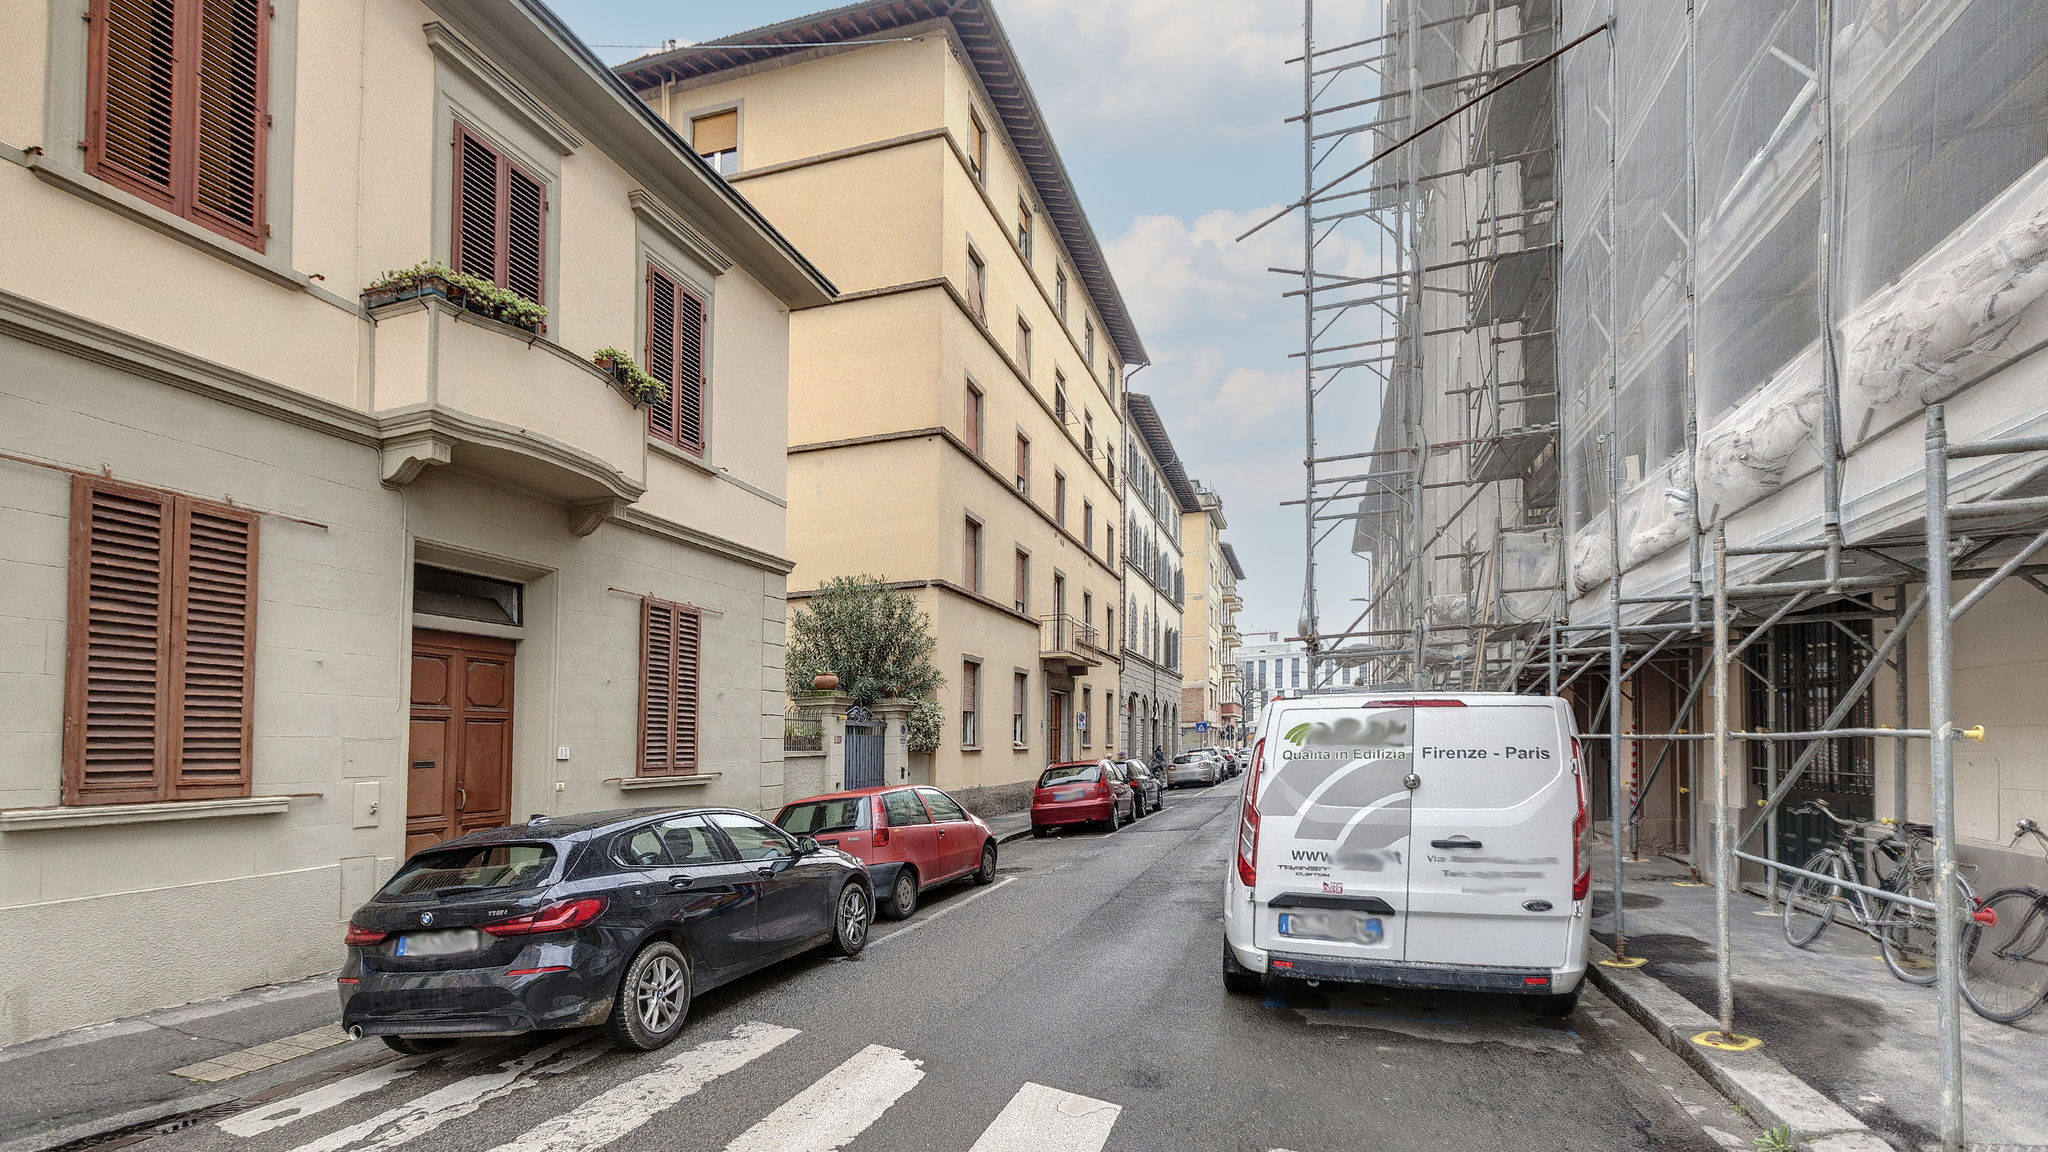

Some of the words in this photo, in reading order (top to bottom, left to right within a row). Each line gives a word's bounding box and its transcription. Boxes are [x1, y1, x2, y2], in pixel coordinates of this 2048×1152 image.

[1335, 750, 1348, 760] in
[1353, 748, 1406, 760] Edilizia
[1422, 746, 1487, 760] Firenze
[1505, 746, 1551, 760] Paris
